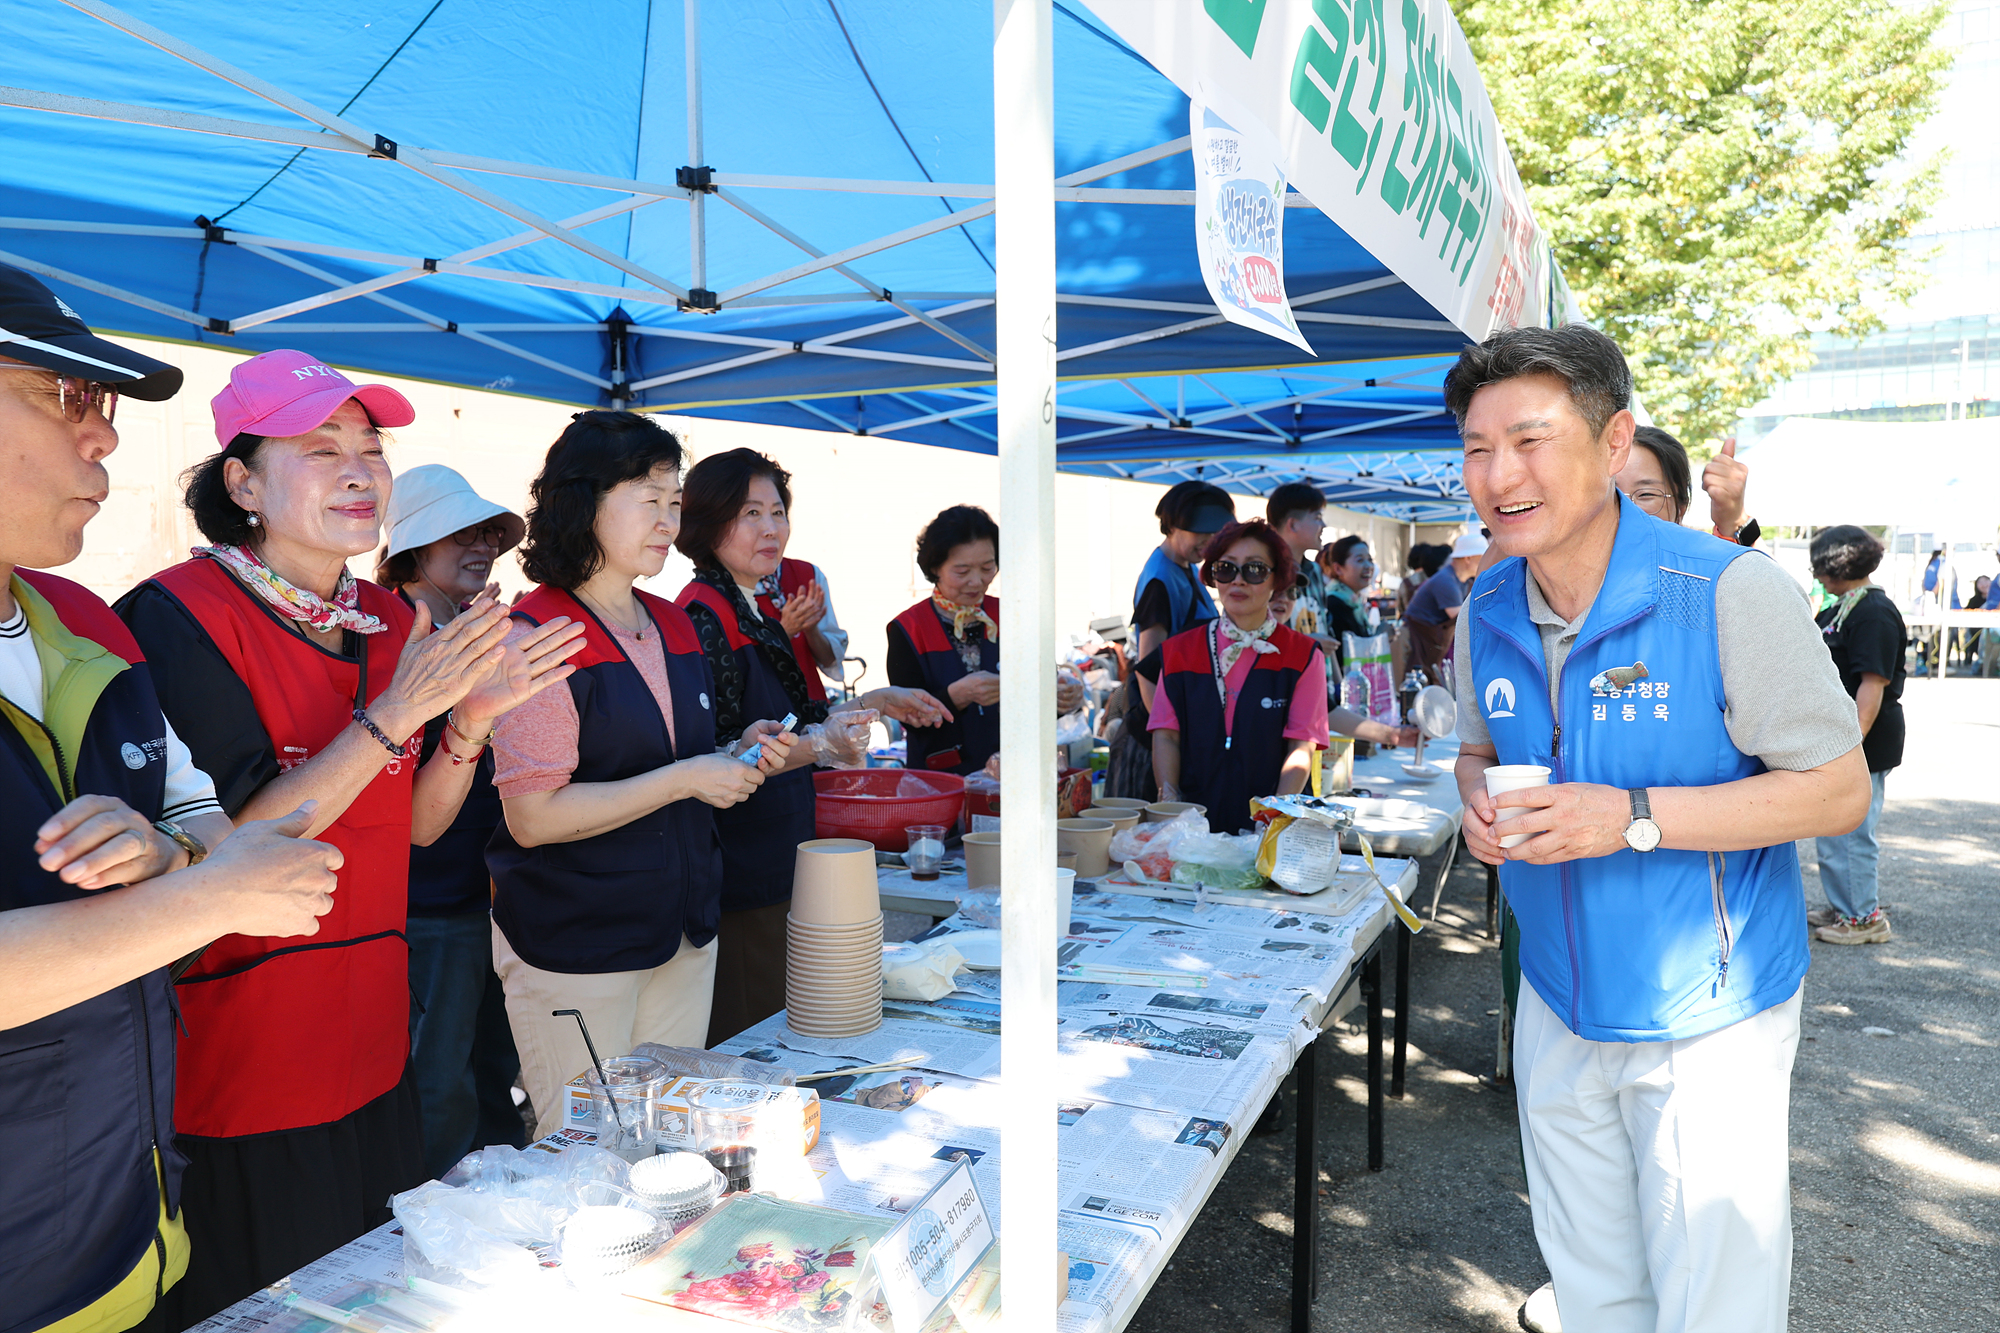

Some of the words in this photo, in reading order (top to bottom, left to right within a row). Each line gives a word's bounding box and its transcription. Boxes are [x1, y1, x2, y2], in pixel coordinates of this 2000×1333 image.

[1220, 186, 1276, 255] 냉잔치국수
[1246, 262, 1280, 298] 3,000원
[1592, 681, 1671, 699] 구청장
[1107, 1207, 1160, 1222] LGE.COM
